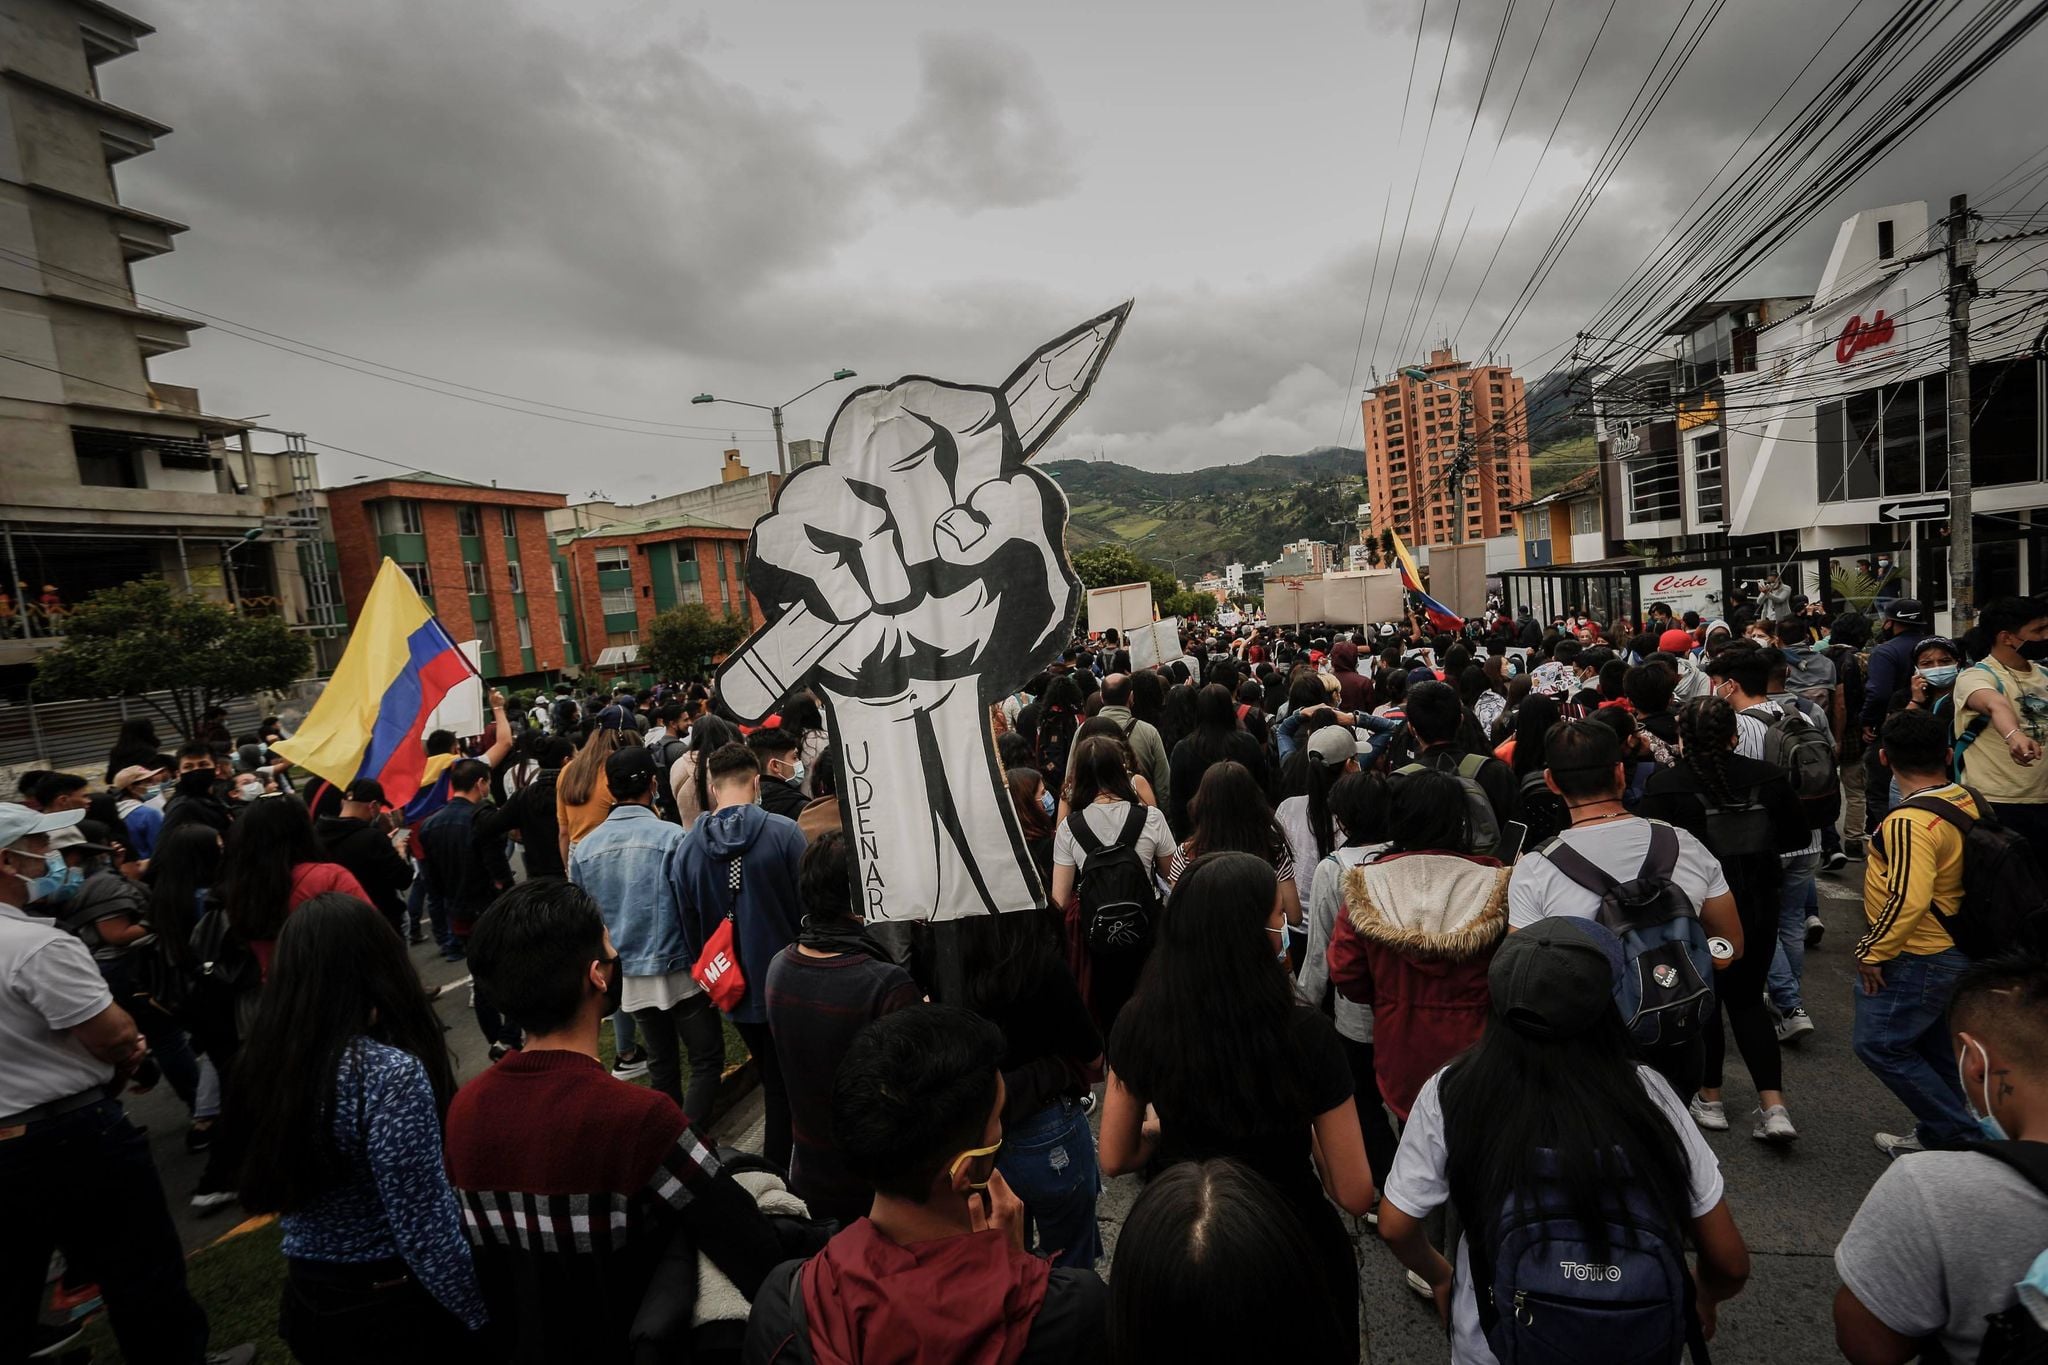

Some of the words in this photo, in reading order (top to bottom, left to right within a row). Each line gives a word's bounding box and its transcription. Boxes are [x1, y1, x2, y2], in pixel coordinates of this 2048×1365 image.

[1653, 575, 1708, 591] Cide
[845, 740, 890, 920] UDENAR
[704, 951, 731, 984] ME
[1560, 1261, 1621, 1282] TOTTO
